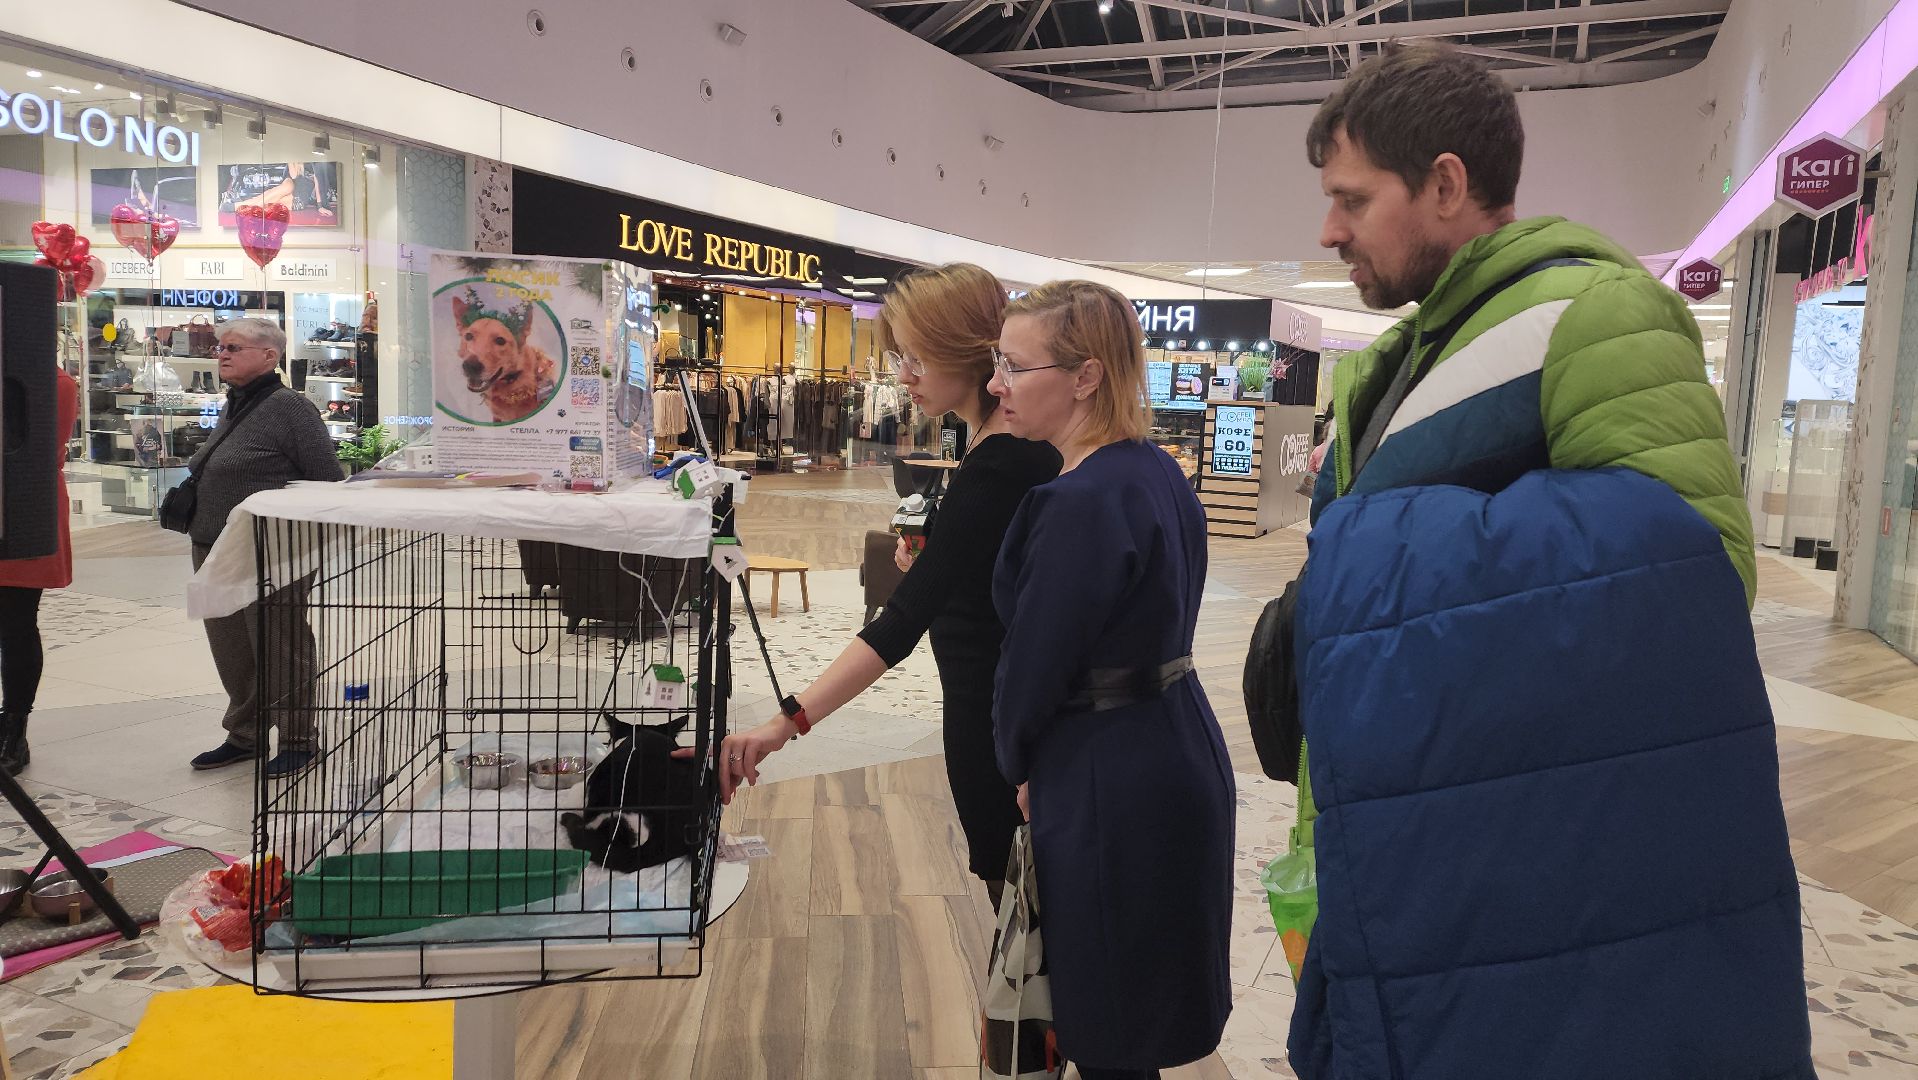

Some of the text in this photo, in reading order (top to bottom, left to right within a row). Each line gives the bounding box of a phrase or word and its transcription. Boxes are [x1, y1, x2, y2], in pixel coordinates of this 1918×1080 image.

[124, 115, 200, 167] NOI
[1791, 154, 1855, 177] kari
[1790, 180, 1830, 189] ГИПЕР
[618, 213, 821, 284] LOVE REPUBLIC
[111, 261, 155, 275] ICEBERG
[200, 261, 226, 275] FABI
[280, 263, 329, 278] Baldinini
[1683, 269, 1719, 282] kari
[509, 426, 541, 435] СТЕЛЛА
[1217, 426, 1252, 437] КОФЕ
[1224, 439, 1246, 452] 60
